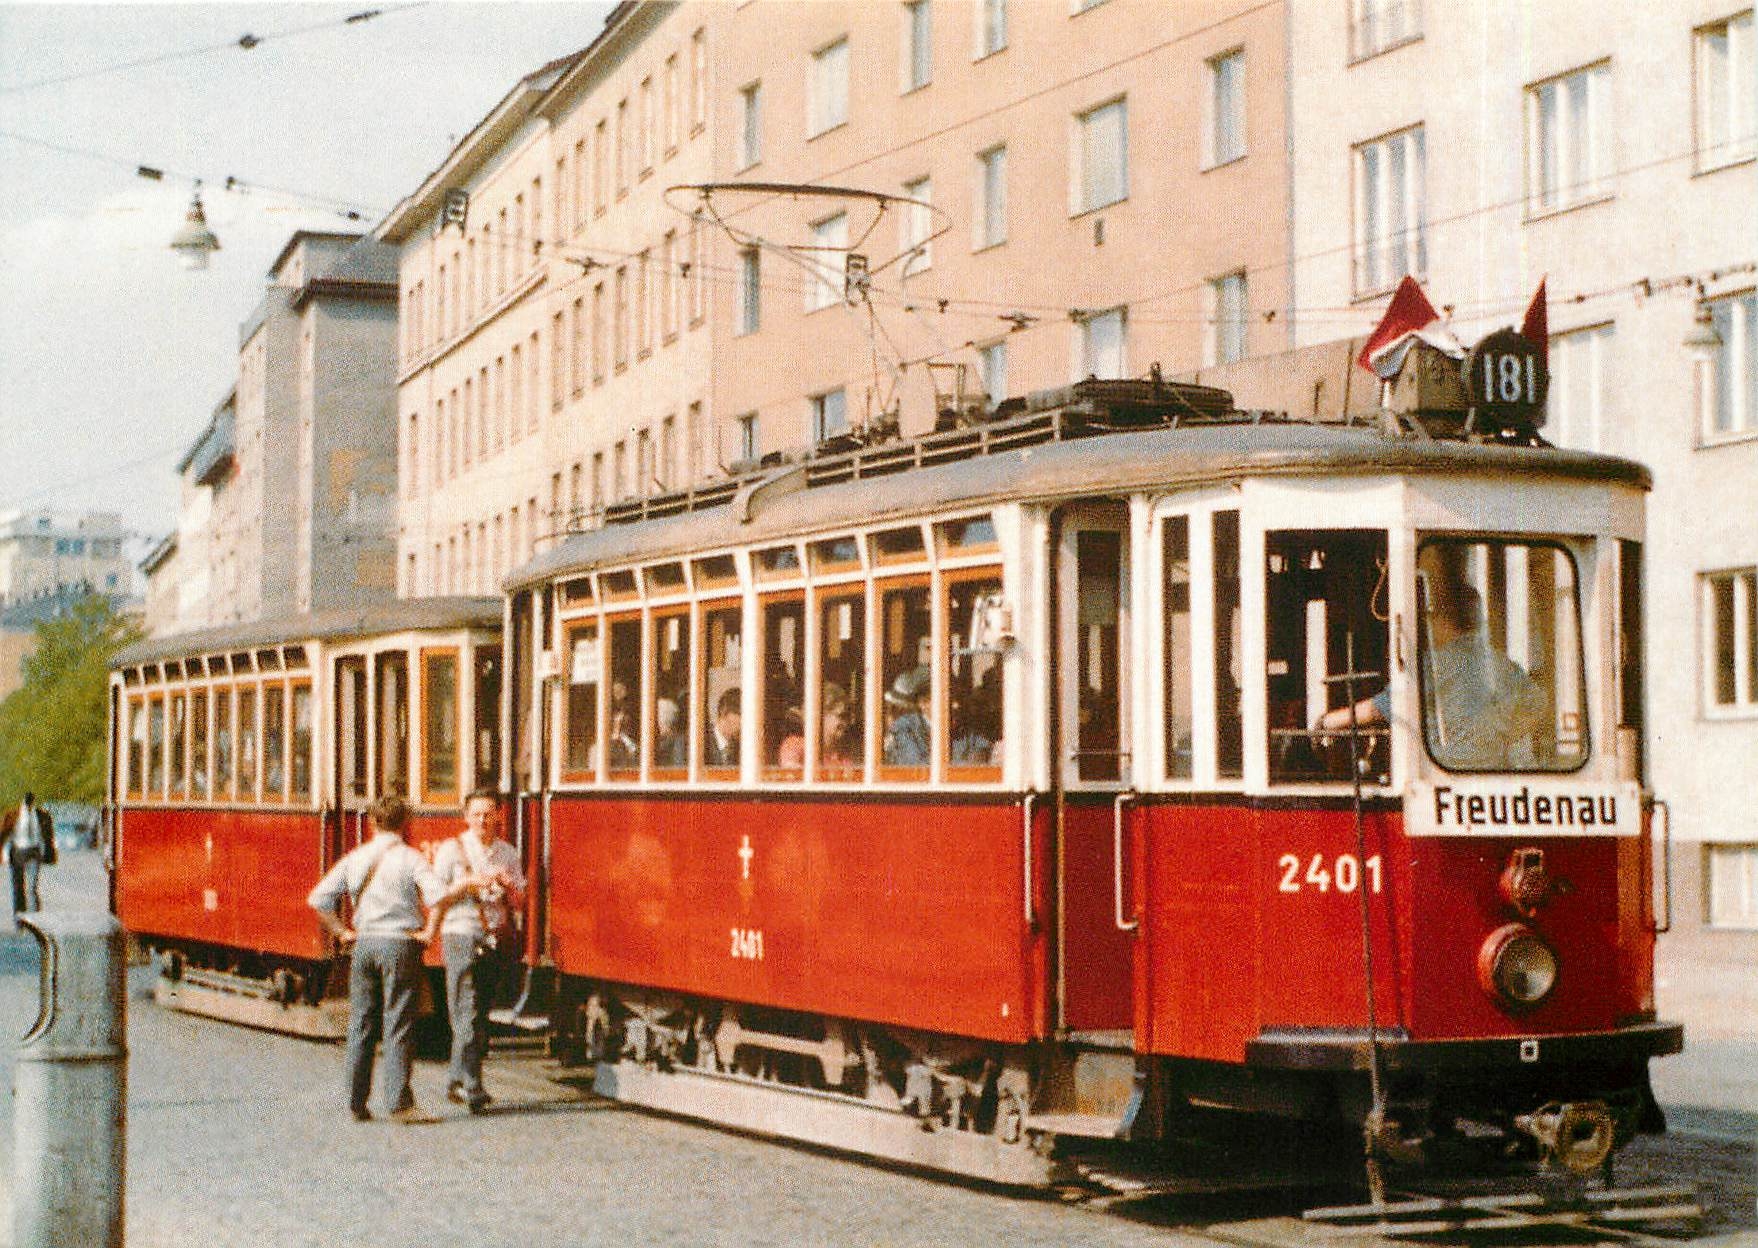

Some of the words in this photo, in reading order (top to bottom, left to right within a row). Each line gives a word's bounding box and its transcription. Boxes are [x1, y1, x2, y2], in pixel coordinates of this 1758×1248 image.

[1484, 354, 1535, 403] 181
[1434, 785, 1617, 825] Freudenau
[1278, 853, 1382, 893] 2401
[730, 927, 764, 960] 2401
